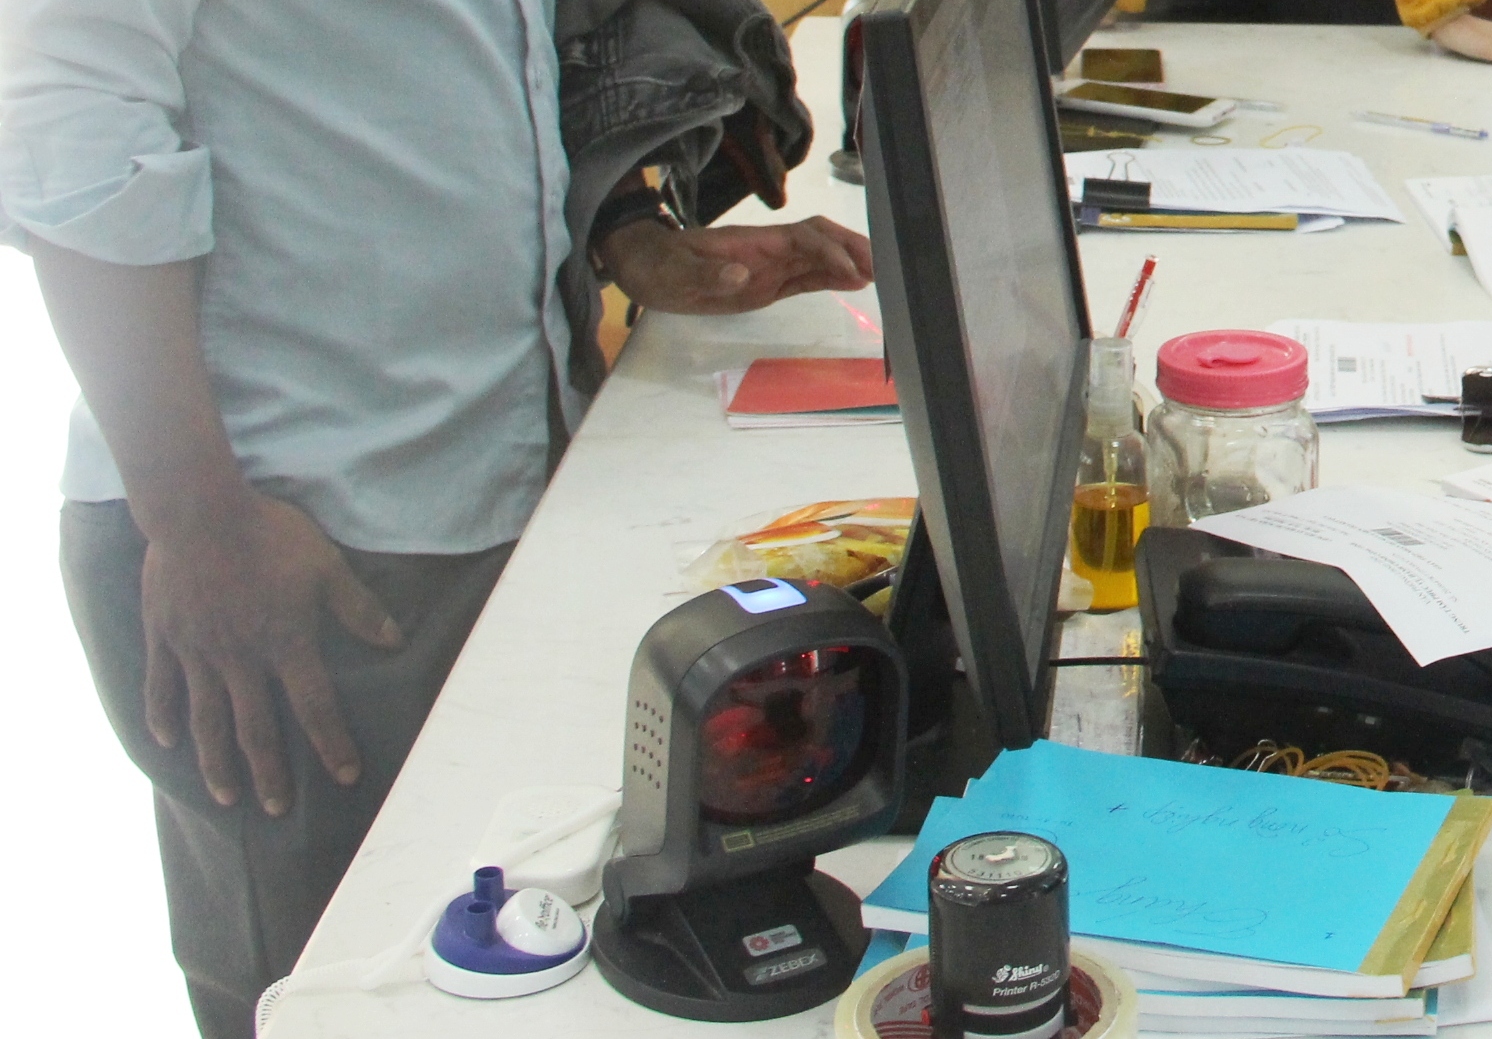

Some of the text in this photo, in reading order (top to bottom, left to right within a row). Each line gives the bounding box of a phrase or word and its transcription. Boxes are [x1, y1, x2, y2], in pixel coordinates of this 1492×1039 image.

[768, 953, 819, 977] ZEBEX
[1007, 963, 1043, 982] Shiny
[992, 985, 1027, 997] Printer
